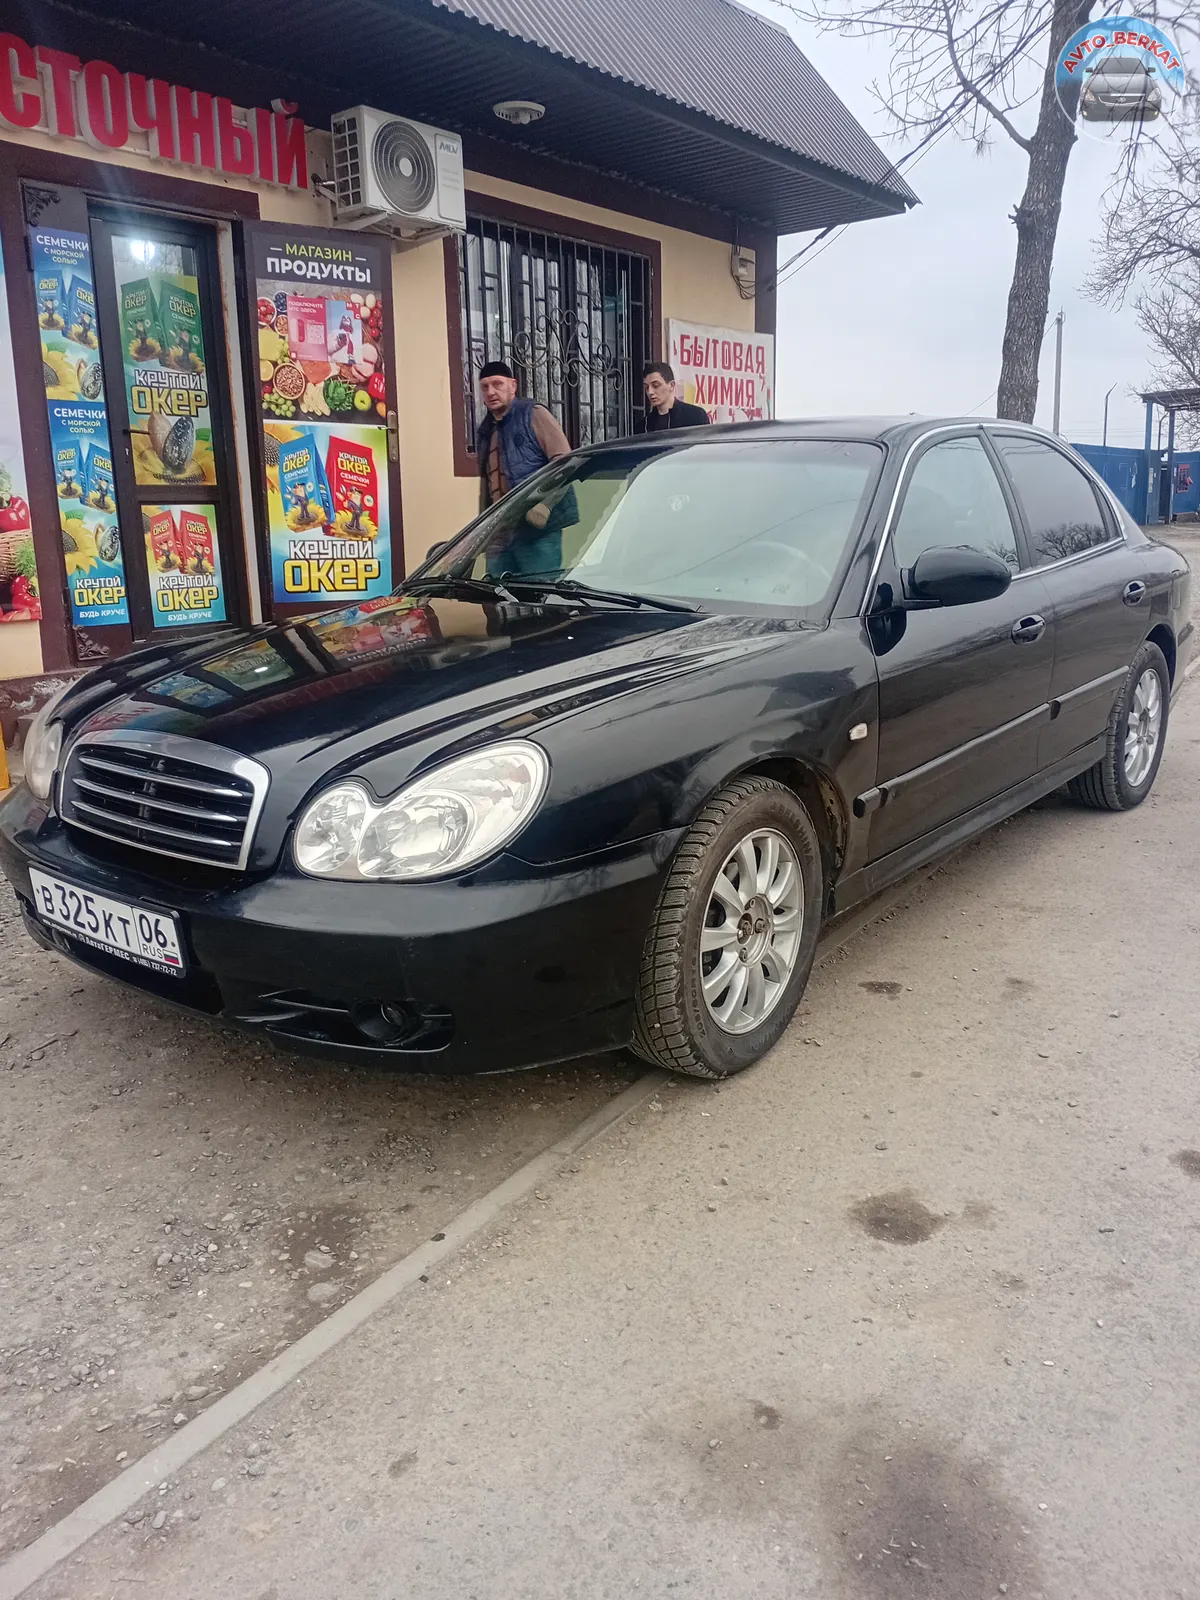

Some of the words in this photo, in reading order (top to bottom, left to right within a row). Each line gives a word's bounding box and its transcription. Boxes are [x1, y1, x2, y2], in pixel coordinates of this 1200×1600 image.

[36, 234, 89, 251] СЕМЕЧКИ
[51, 248, 84, 259] МОРСКОЙ
[52, 256, 78, 266] СОЛЬЮ
[285, 243, 353, 262] МАГАЗИН
[266, 257, 371, 283] ПРОДУКТЫ
[680, 334, 765, 375] БЫТОВАЯ
[135, 369, 201, 390] КРУТОЙ
[695, 373, 755, 408] ХИМИЯ
[131, 385, 208, 417] ОКЕР
[53, 407, 107, 420] СЕМЕЧКИ
[338, 451, 368, 465] КРУТОЙ
[289, 538, 373, 559] КРУТОЙ
[76, 575, 122, 589] КРУТОЙ
[159, 573, 214, 590] КРУТОЙ
[283, 558, 381, 593] ОКЕР
[74, 587, 126, 607] ОКЕР
[156, 586, 219, 613] ОКЕР
[79, 610, 100, 618] БУДЬ
[101, 608, 125, 617] КРУЧЕ
[167, 612, 188, 622] БУДЬ
[188, 610, 213, 620] КРУЧЕ
[138, 913, 168, 948] 06
[142, 943, 164, 960] RUS
